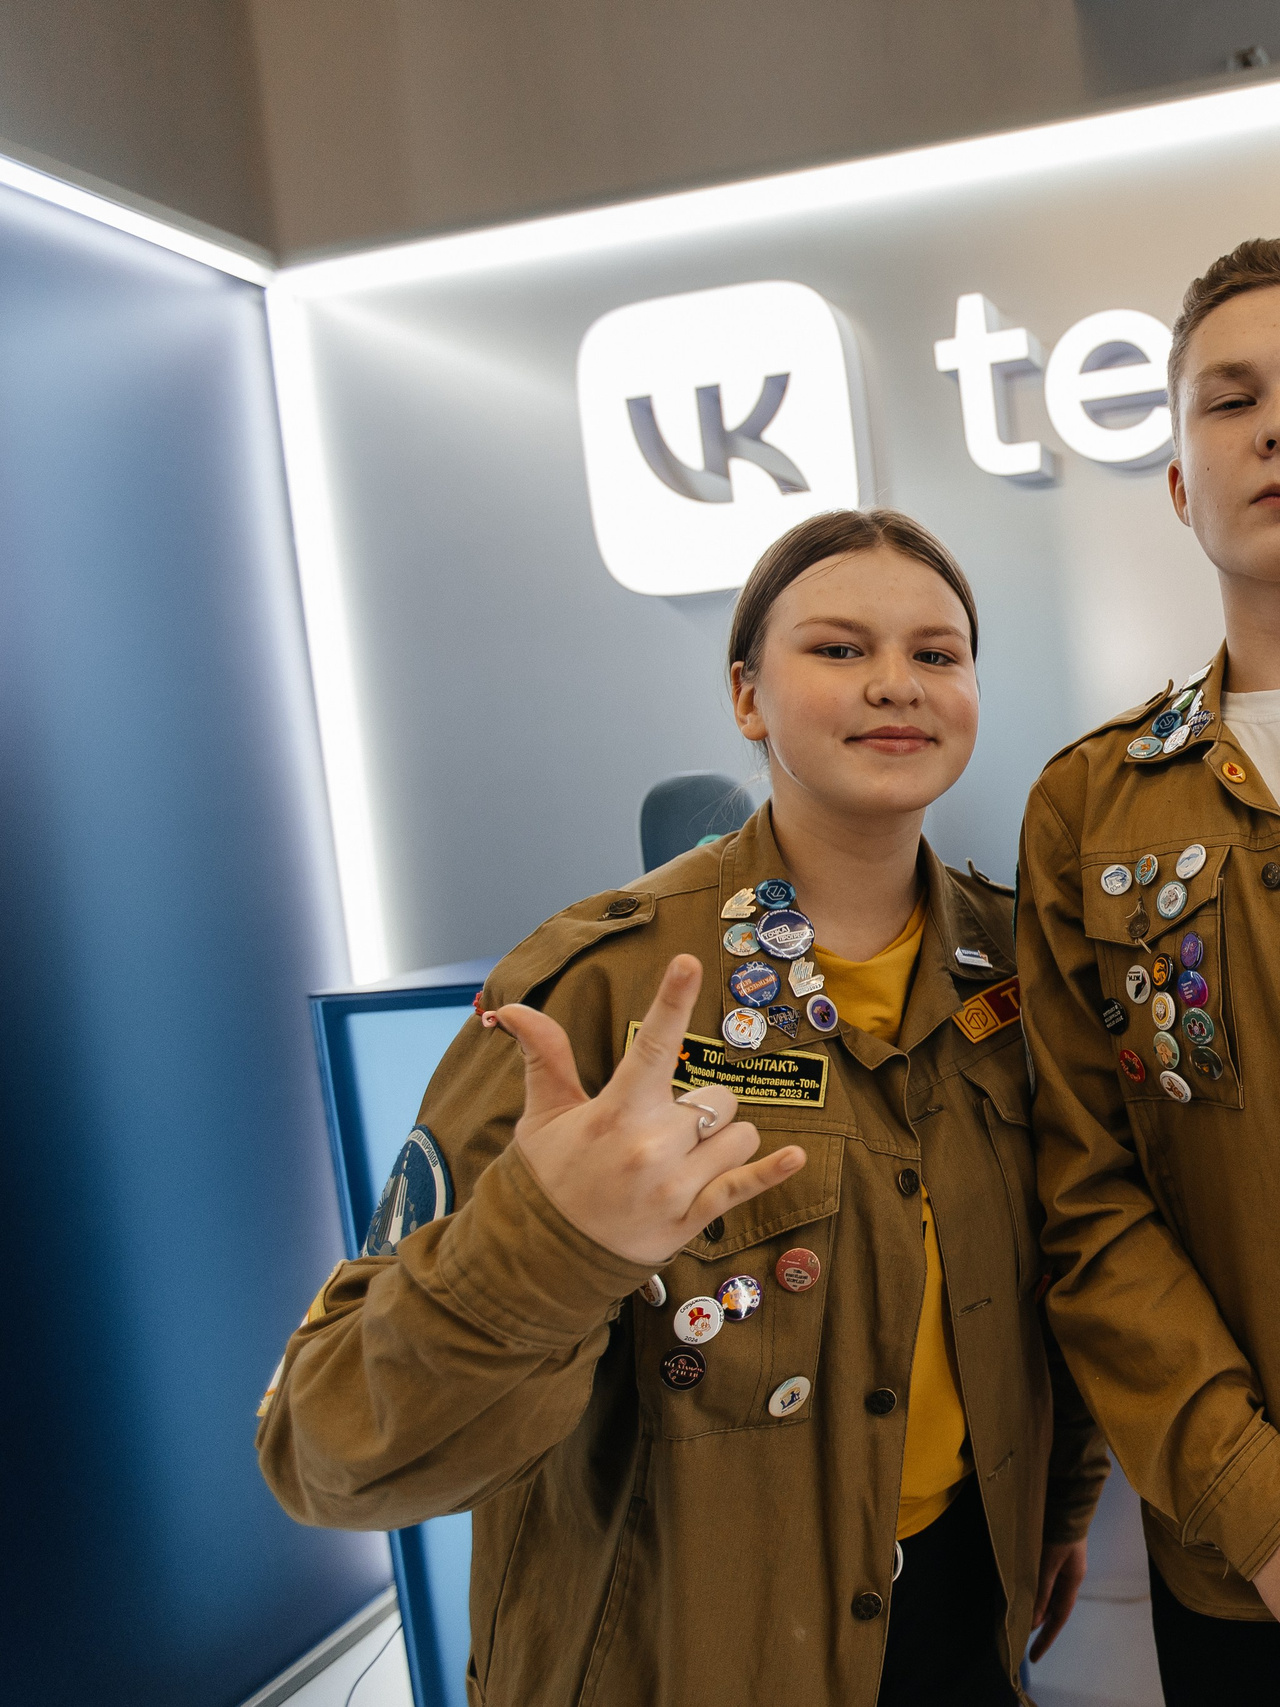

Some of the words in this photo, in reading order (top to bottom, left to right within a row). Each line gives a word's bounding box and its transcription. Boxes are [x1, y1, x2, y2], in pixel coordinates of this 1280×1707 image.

[763, 926, 788, 939] ТОЧКА
[702, 1048, 725, 1066] ТОП
[685, 1061, 715, 1079] Трудовой
[716, 1069, 745, 1084] проект
[745, 1084, 778, 1097] область
[780, 1088, 802, 1099] 2023
[683, 1335, 698, 1343] 2024
